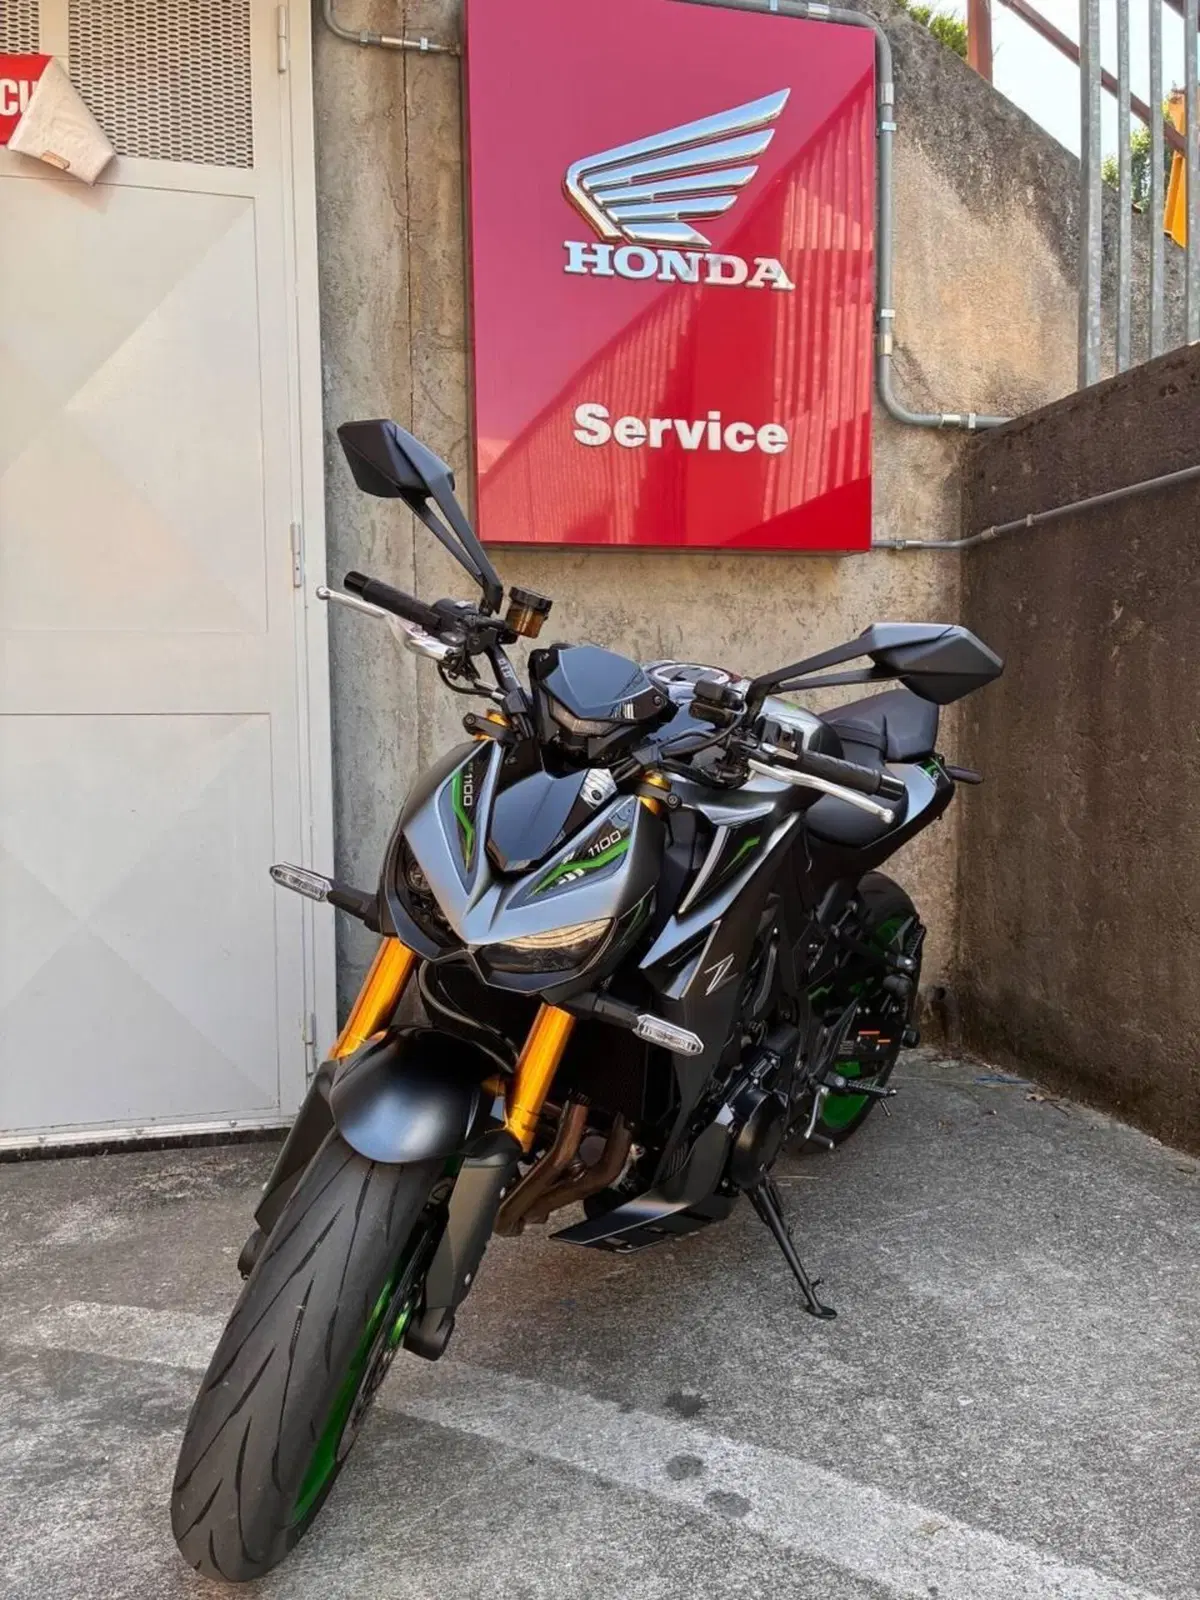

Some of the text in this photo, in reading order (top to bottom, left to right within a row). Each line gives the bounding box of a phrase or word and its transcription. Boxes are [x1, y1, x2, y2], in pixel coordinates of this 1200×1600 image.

[563, 241, 796, 290] HONDA
[573, 403, 789, 454] Service
[463, 773, 473, 806] 1100
[588, 830, 621, 857] 1100
